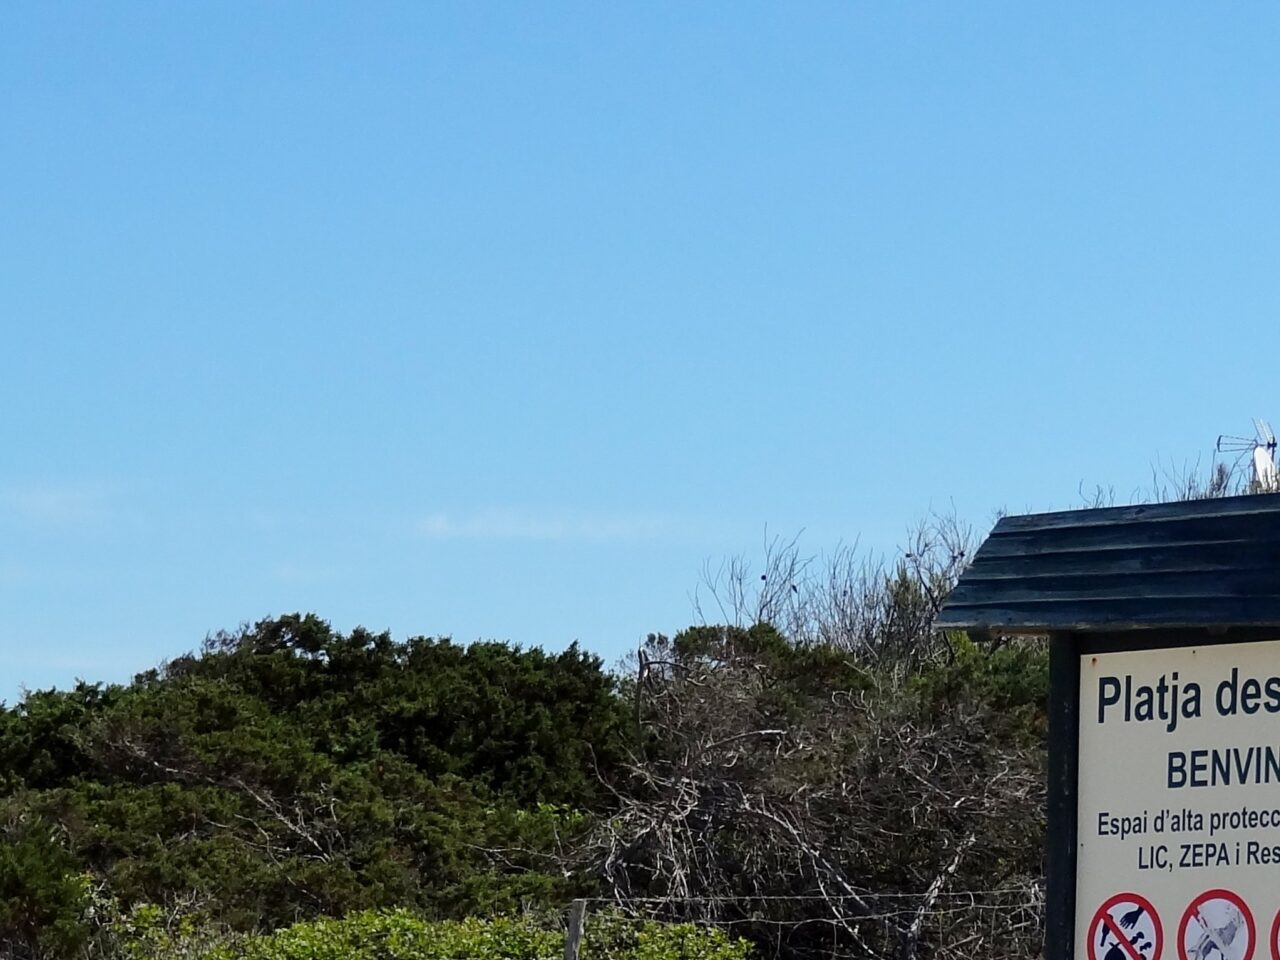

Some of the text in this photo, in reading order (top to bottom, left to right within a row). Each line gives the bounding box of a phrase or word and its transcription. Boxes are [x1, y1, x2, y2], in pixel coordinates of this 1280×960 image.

[1098, 672, 1201, 732] Platja
[1098, 810, 1147, 840] Espai
[1154, 808, 1203, 833] d’alta
[1139, 845, 1172, 872] LIC,
[1179, 843, 1230, 867] ZEPA
[1236, 842, 1240, 865] i
